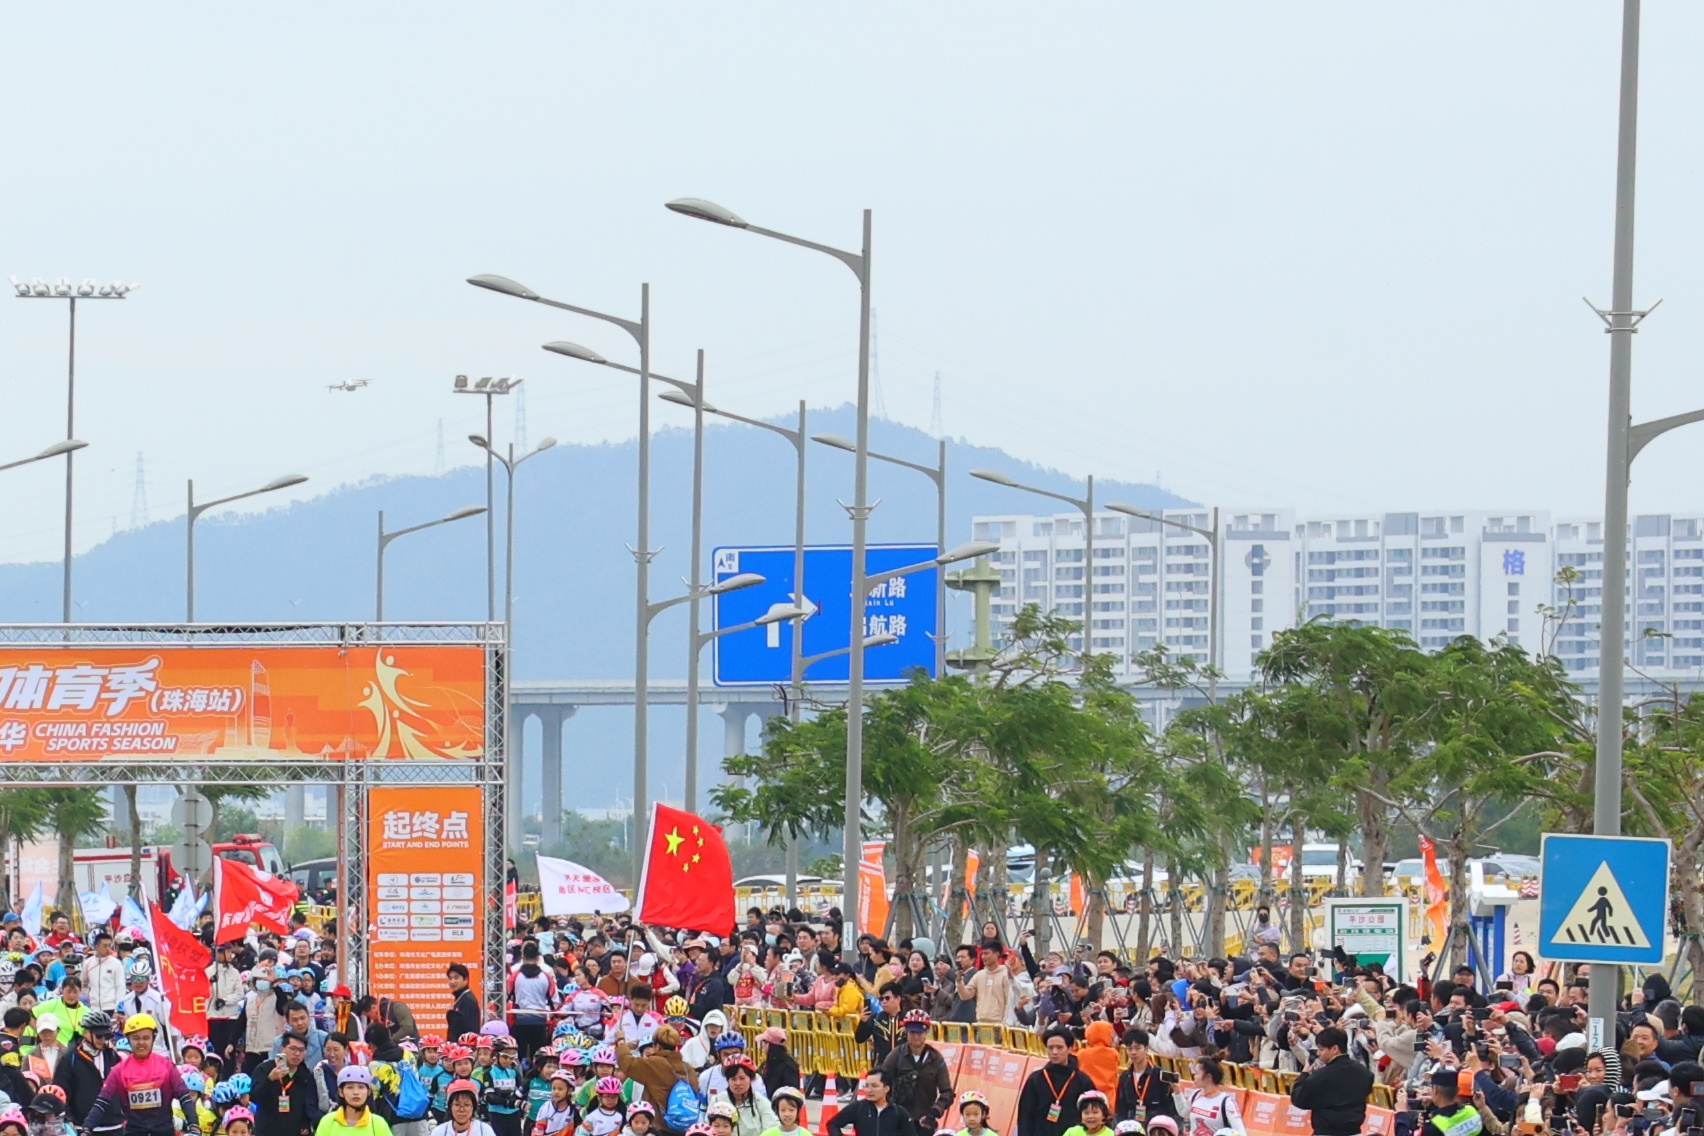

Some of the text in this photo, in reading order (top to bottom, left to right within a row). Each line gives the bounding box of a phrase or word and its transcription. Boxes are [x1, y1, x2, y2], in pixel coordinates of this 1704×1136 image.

[1502, 549, 1526, 575] 格
[151, 688, 242, 713] (珠海站)
[35, 722, 164, 737] CHINA FASHION
[47, 737, 177, 751] SPORTS SEASON
[382, 811, 469, 840] 起终点
[382, 841, 469, 849] START AND END POINTS
[1349, 914, 1385, 924] 平沙公园
[130, 1091, 159, 1104] 0921
